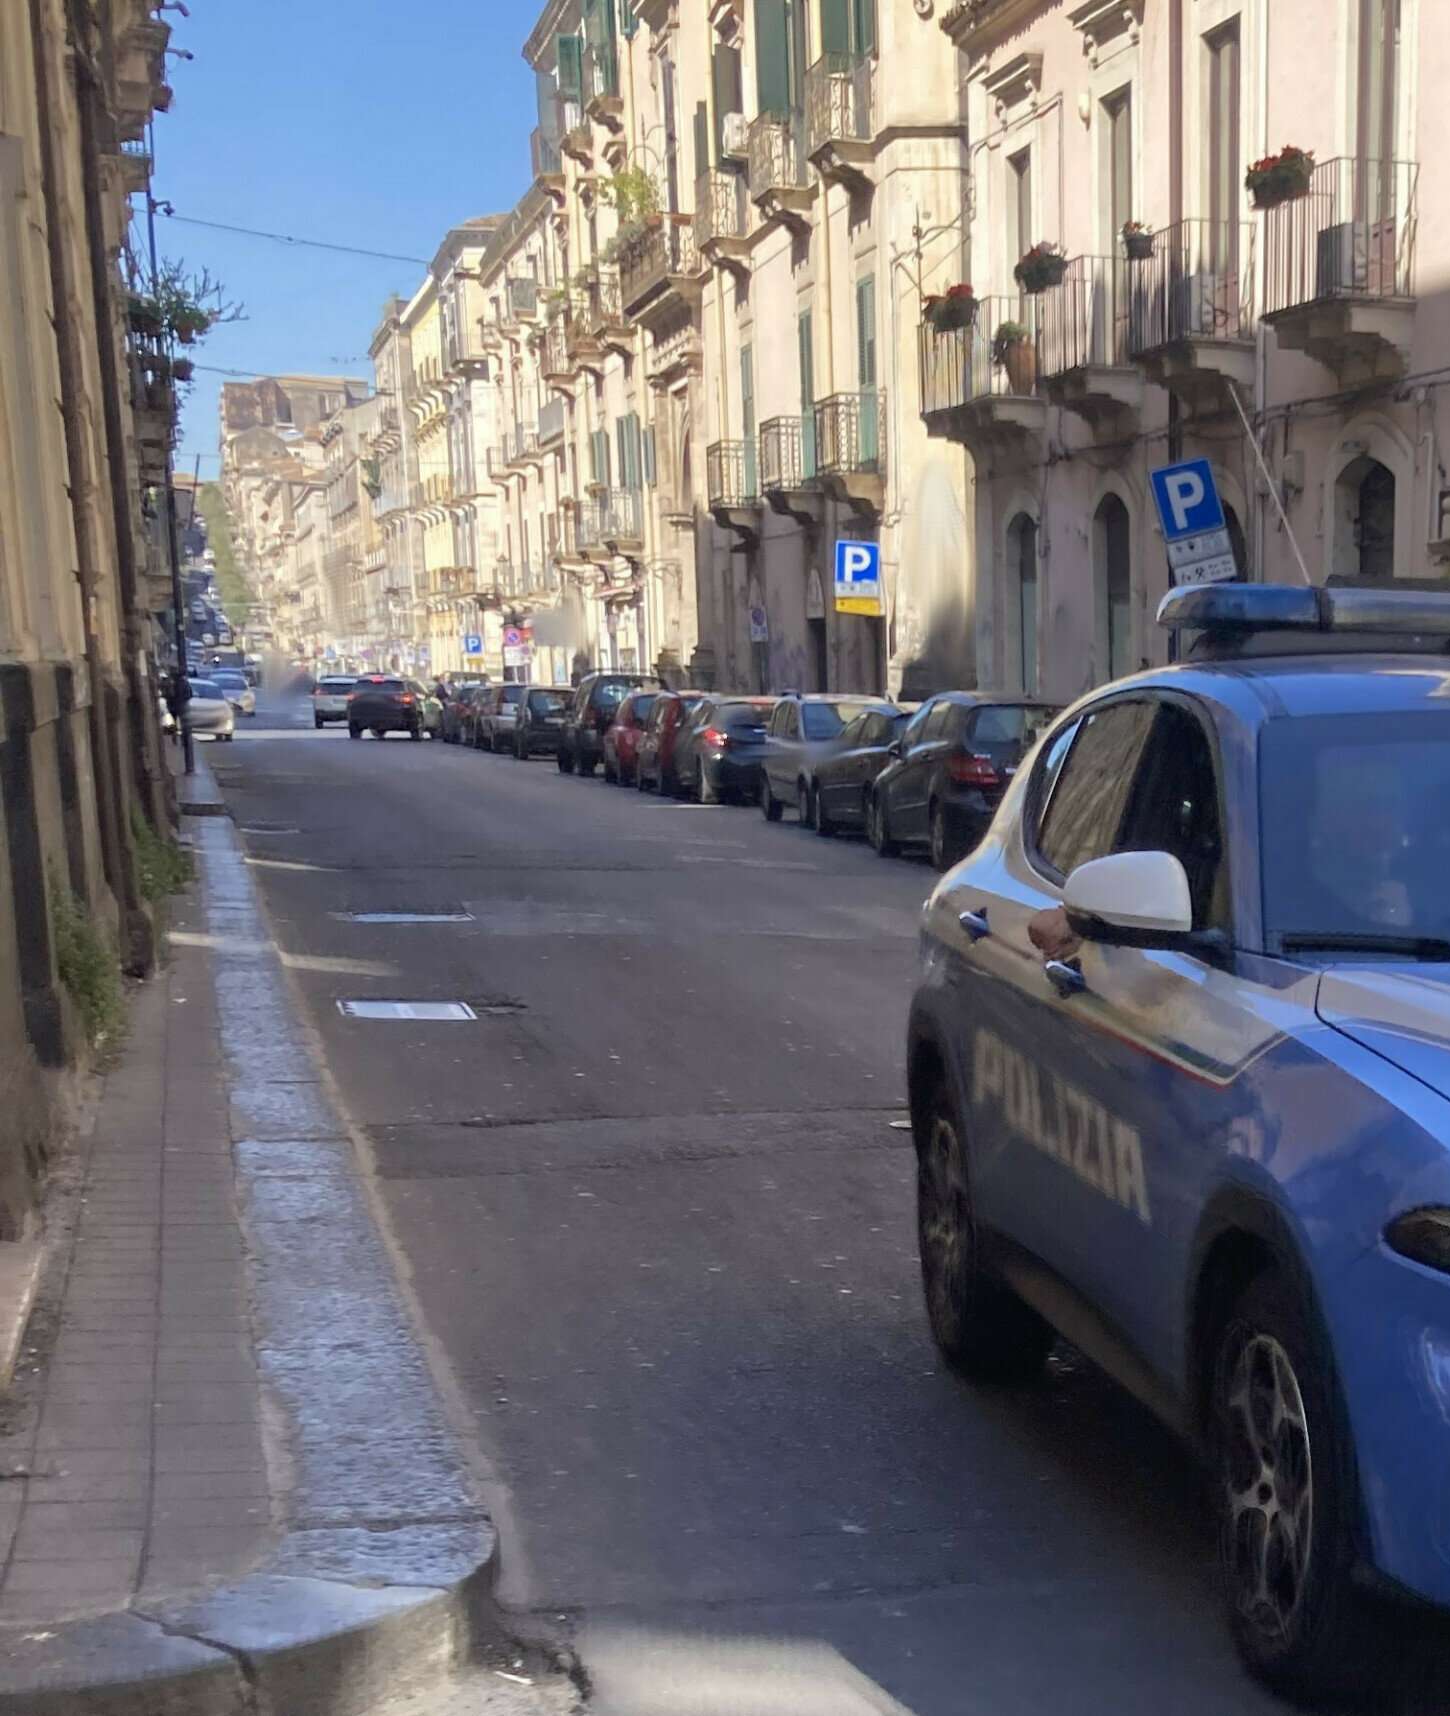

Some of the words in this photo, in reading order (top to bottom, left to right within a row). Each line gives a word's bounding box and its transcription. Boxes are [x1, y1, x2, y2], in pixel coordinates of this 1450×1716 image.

[1165, 471, 1204, 530] P
[844, 546, 871, 582] P
[468, 638, 479, 651] P
[974, 1028, 1150, 1223] POLIZIA
